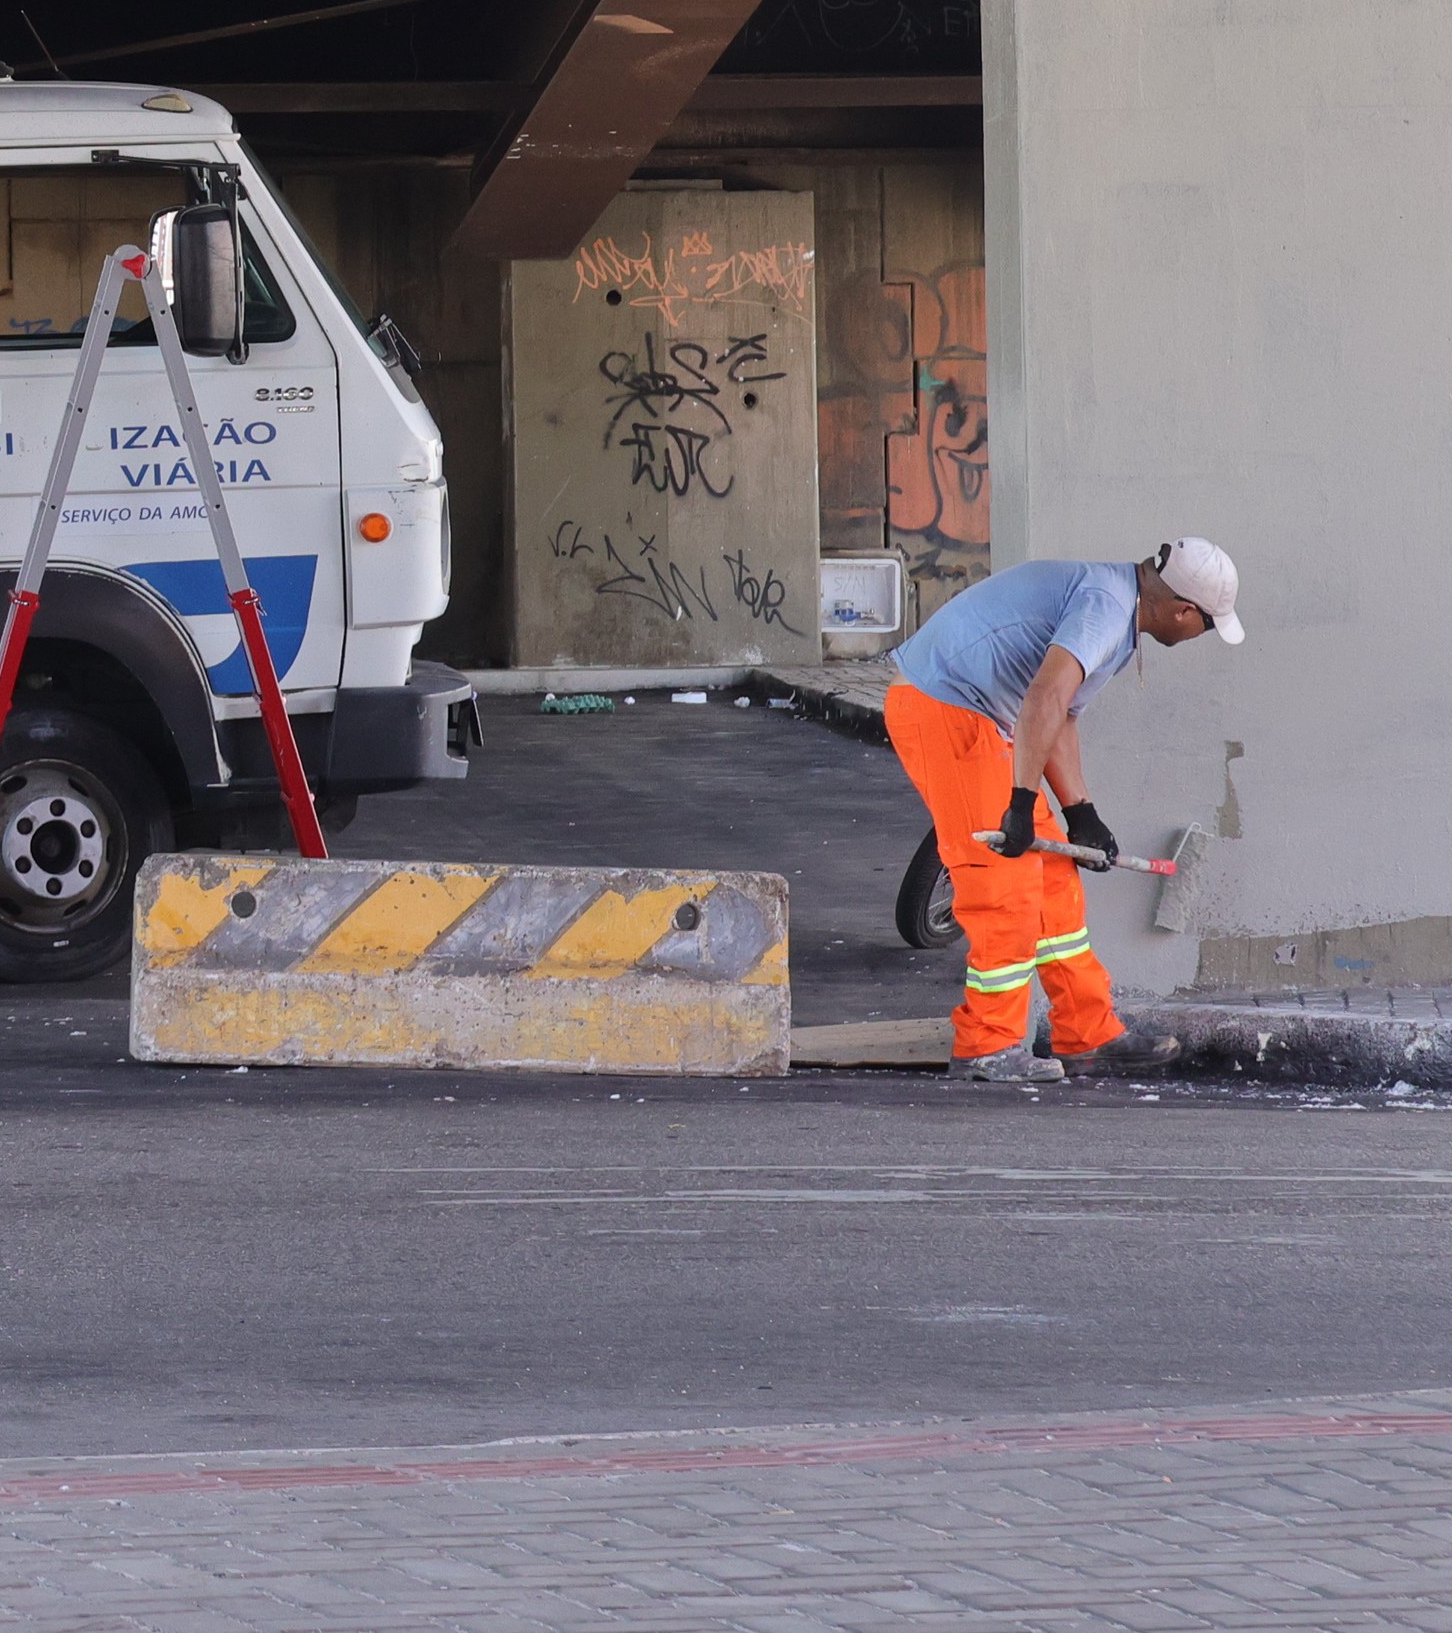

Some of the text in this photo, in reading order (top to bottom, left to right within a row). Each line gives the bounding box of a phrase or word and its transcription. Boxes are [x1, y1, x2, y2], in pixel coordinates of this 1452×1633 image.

[109, 417, 278, 451] IZAÃO
[60, 506, 132, 525] SERVIÇO
[139, 506, 163, 521] DA
